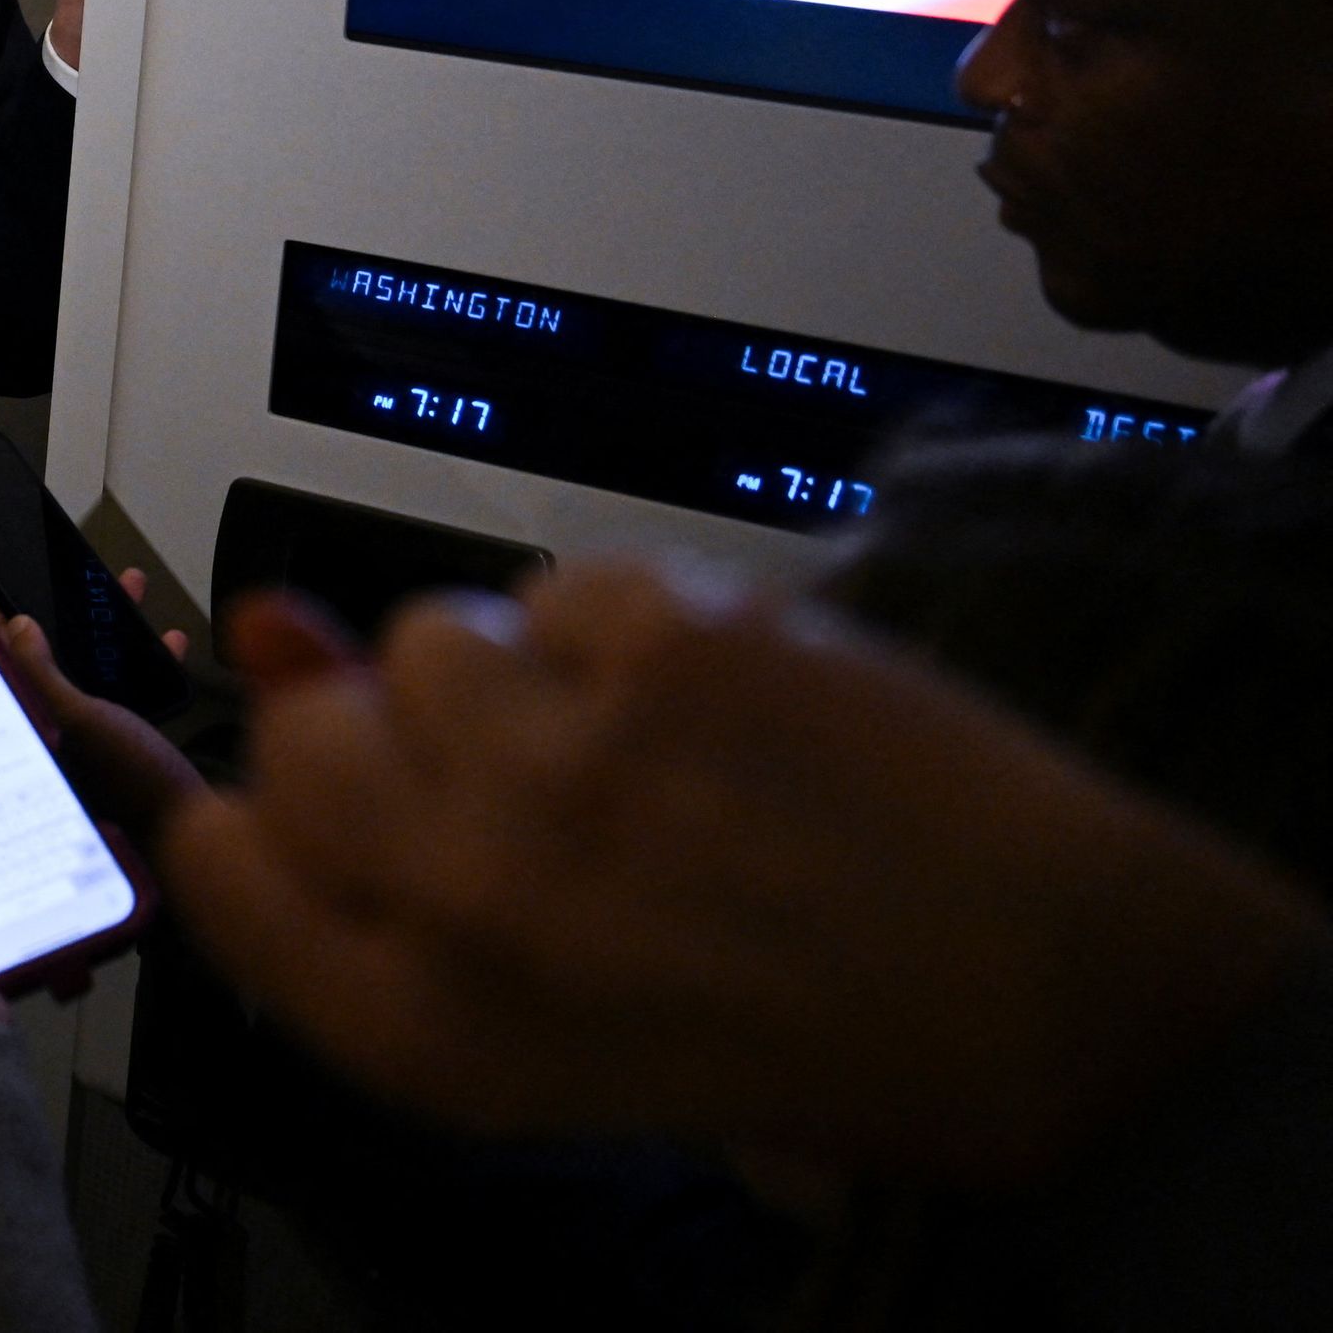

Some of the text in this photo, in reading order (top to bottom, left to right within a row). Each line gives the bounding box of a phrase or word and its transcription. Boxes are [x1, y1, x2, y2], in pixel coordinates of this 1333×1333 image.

[331, 268, 561, 333] WASHINGTON
[741, 346, 867, 396] LOCAL
[373, 387, 490, 431] PM 7:17
[780, 467, 874, 514] 7:17
